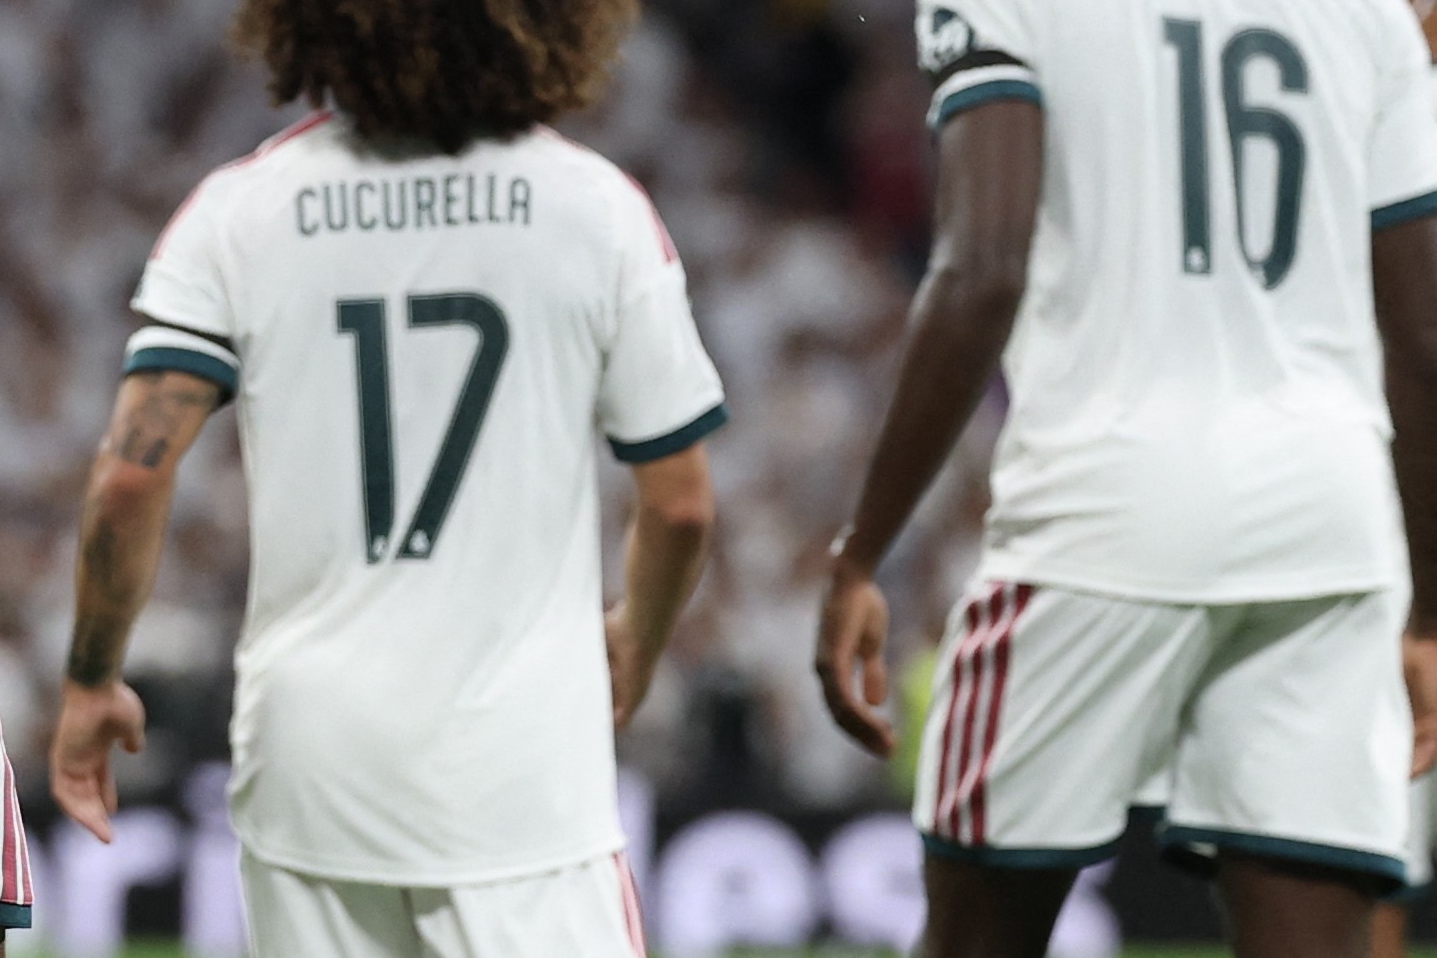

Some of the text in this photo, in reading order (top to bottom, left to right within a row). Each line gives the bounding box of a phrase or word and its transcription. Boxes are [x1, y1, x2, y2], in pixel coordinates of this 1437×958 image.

[294, 172, 532, 235] CUCURELLA
[1164, 16, 1309, 291] 16
[336, 292, 511, 564] 17
